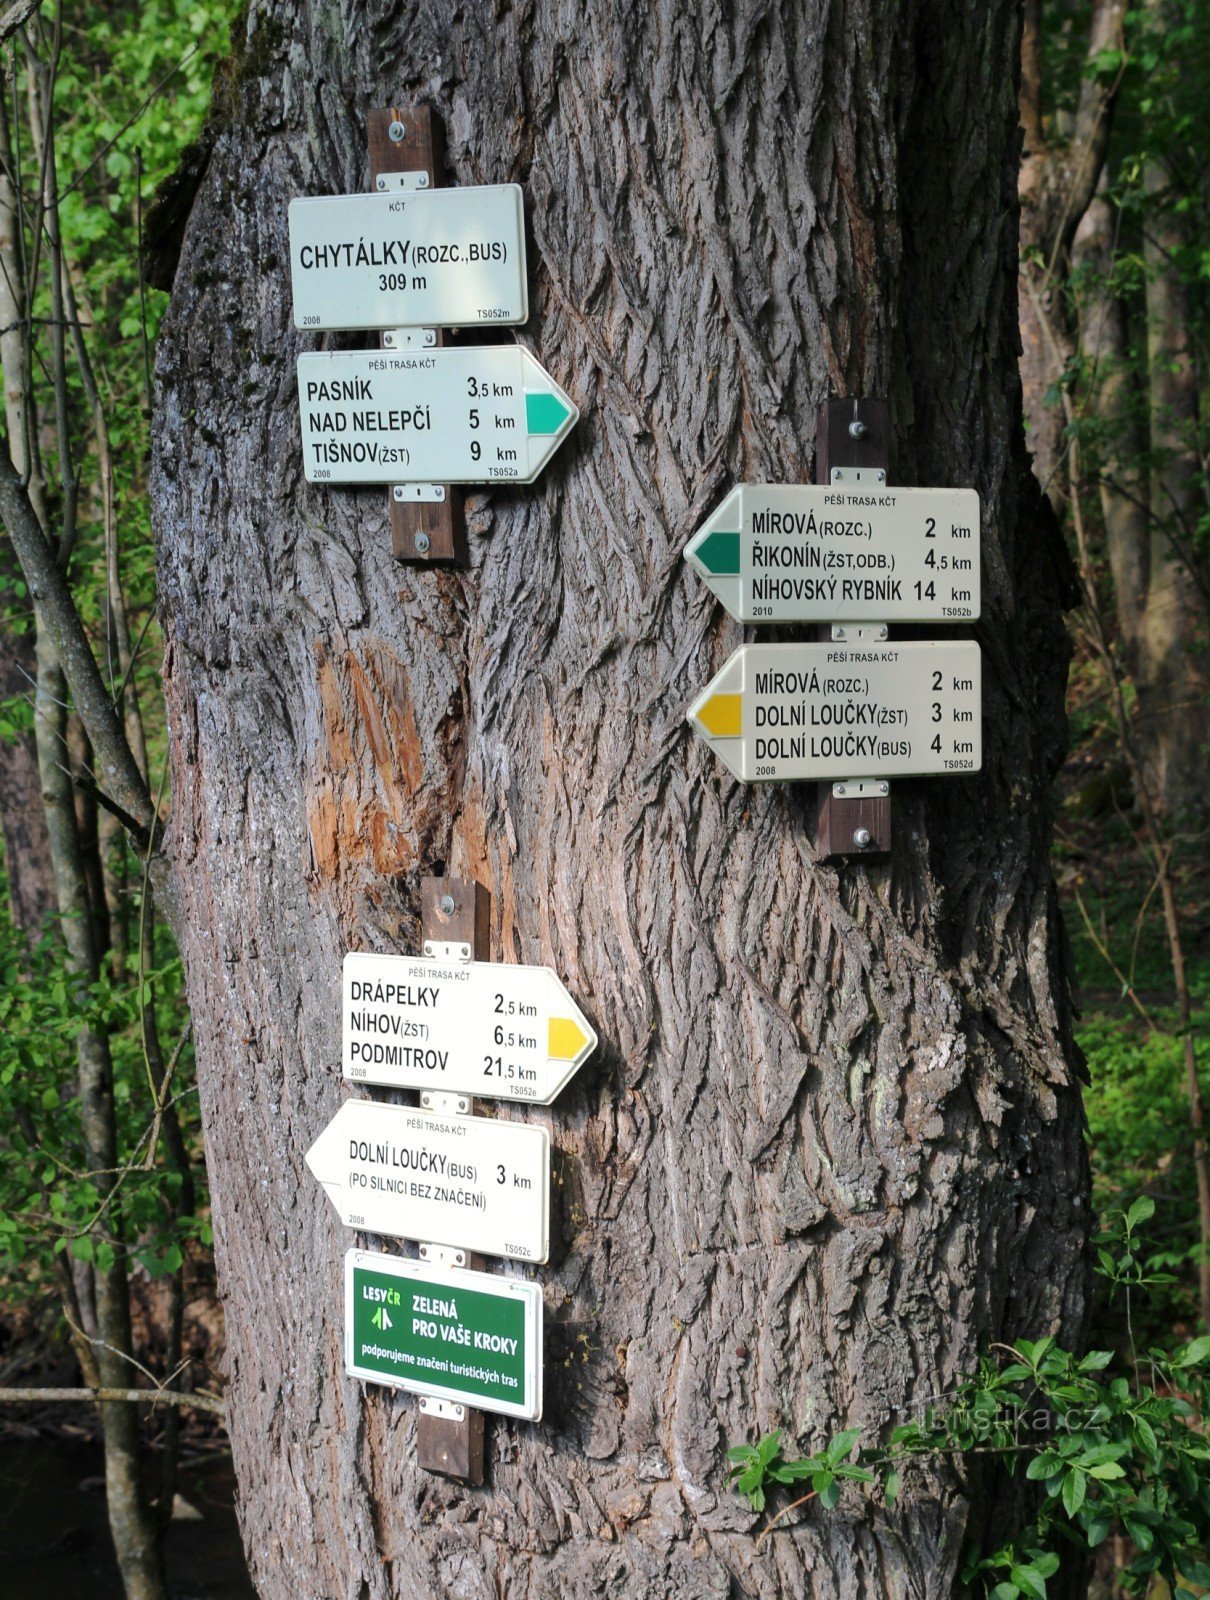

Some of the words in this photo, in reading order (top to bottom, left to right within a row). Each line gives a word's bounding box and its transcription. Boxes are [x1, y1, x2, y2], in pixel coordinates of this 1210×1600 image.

[389, 201, 406, 212] KČT
[379, 273, 406, 291] 309
[413, 276, 427, 290] m
[303, 316, 321, 325] 2008
[477, 309, 510, 319] TS052m
[389, 360, 418, 370] TRASA
[419, 359, 436, 369] KČT
[307, 376, 373, 401] PASNÍK
[467, 377, 489, 399] 3,5
[493, 383, 513, 396] km
[309, 411, 347, 432] NAD
[353, 405, 431, 431] NELEPČÍ
[469, 409, 480, 429] 5
[495, 415, 515, 429] km
[470, 441, 481, 461] 9
[497, 447, 517, 461] km
[313, 470, 331, 478] 2008
[488, 467, 518, 477] TS052a
[847, 497, 877, 506] TRASA
[879, 497, 896, 507] KČT
[925, 518, 936, 538] 2
[951, 525, 971, 538] km
[924, 549, 948, 571] 4,5
[952, 557, 971, 570] km
[752, 575, 836, 600] NÍHOVSKÝ
[842, 575, 902, 600] RYBNÍK
[914, 581, 936, 601] 14
[951, 588, 971, 601] km
[752, 607, 773, 616] 2010
[942, 608, 971, 617] TS052b
[849, 653, 879, 662] TRASA
[881, 652, 899, 662] KČT
[932, 671, 943, 691] 2
[953, 677, 973, 691] km
[755, 700, 806, 727] DOLNÍ
[931, 703, 942, 723] 3
[953, 708, 973, 722] km
[755, 732, 806, 759] DOLNÍ
[931, 734, 942, 754] 4
[953, 740, 973, 753] km
[756, 766, 776, 776] 2008
[943, 760, 973, 770] TS052d
[427, 970, 453, 980] TRASA
[454, 971, 470, 981] KČT
[351, 979, 440, 1008] DRÁPELKY
[494, 994, 515, 1016] 2,5
[519, 1002, 537, 1017] km
[494, 1025, 515, 1047] 6,5
[519, 1034, 537, 1049] km
[351, 1042, 449, 1071] PODMITROV
[483, 1056, 515, 1080] 21,5
[519, 1066, 537, 1081] km
[350, 1068, 367, 1077] 2008
[510, 1085, 537, 1096] TS052e
[425, 1122, 450, 1133] TRASA
[451, 1126, 467, 1136] KČT
[349, 1140, 389, 1165] DOLNÍ
[496, 1164, 506, 1184] 3
[514, 1174, 531, 1189] km
[349, 1172, 367, 1189] (PO
[370, 1176, 407, 1195] SILNICI
[410, 1183, 431, 1199] BEZ
[434, 1187, 486, 1212] ZNAČENÍ)
[349, 1215, 365, 1225] 2008
[505, 1243, 531, 1256] TS052c
[412, 1295, 458, 1319] ZELENÁ
[412, 1319, 437, 1338] PRO
[440, 1323, 471, 1346] VAŠE
[474, 1332, 518, 1356] KROKY
[362, 1344, 415, 1365] podporujeme
[417, 1356, 448, 1372] značení
[450, 1360, 500, 1386] turistických
[501, 1373, 518, 1387] tras
